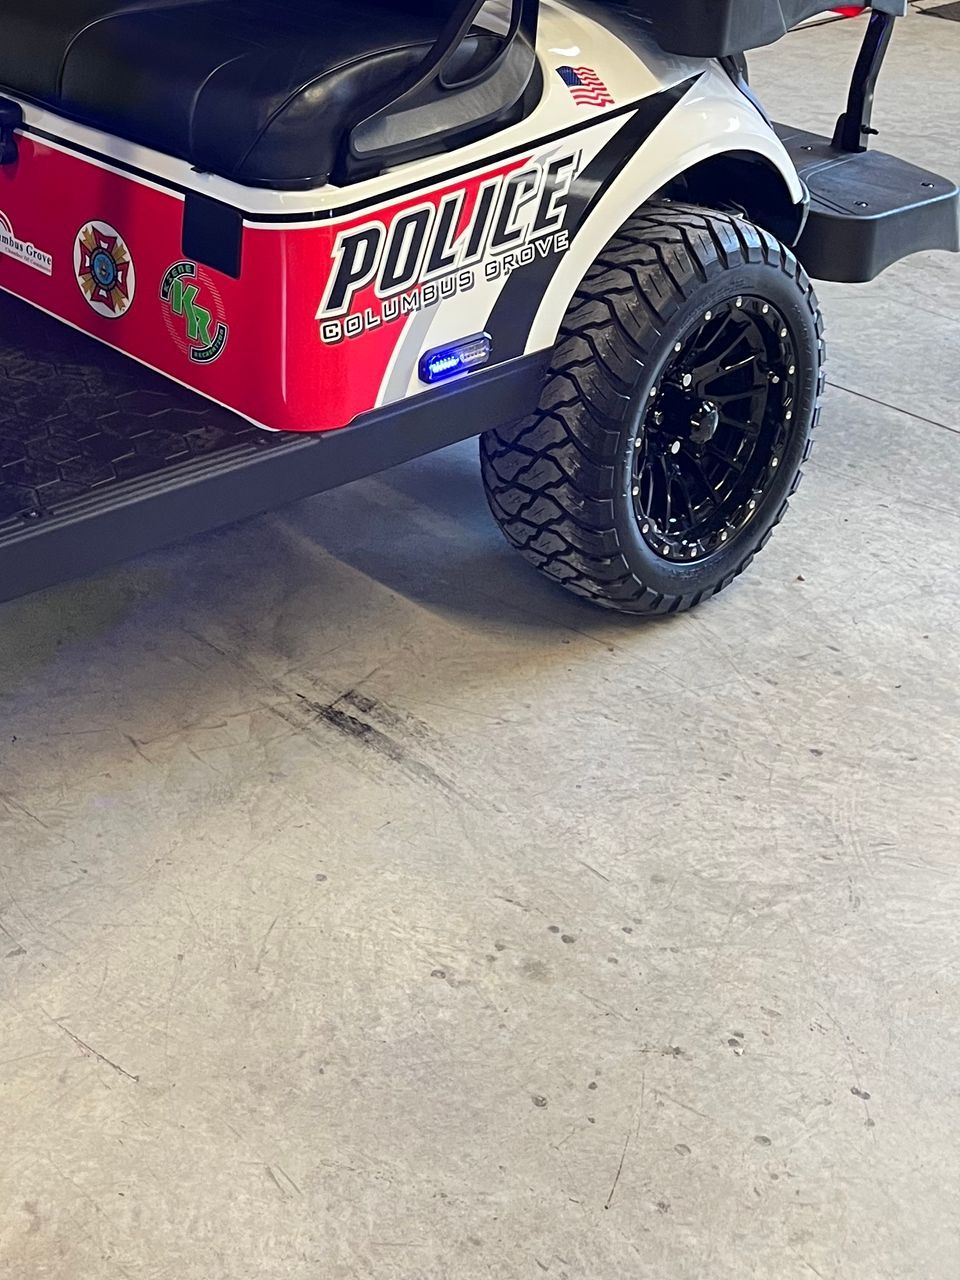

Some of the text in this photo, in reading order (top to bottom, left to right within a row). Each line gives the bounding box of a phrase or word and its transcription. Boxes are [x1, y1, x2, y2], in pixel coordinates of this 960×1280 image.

[26, 244, 52, 265] Grove
[318, 151, 582, 318] POLICE
[321, 231, 570, 343] COLUMBUS GROVE
